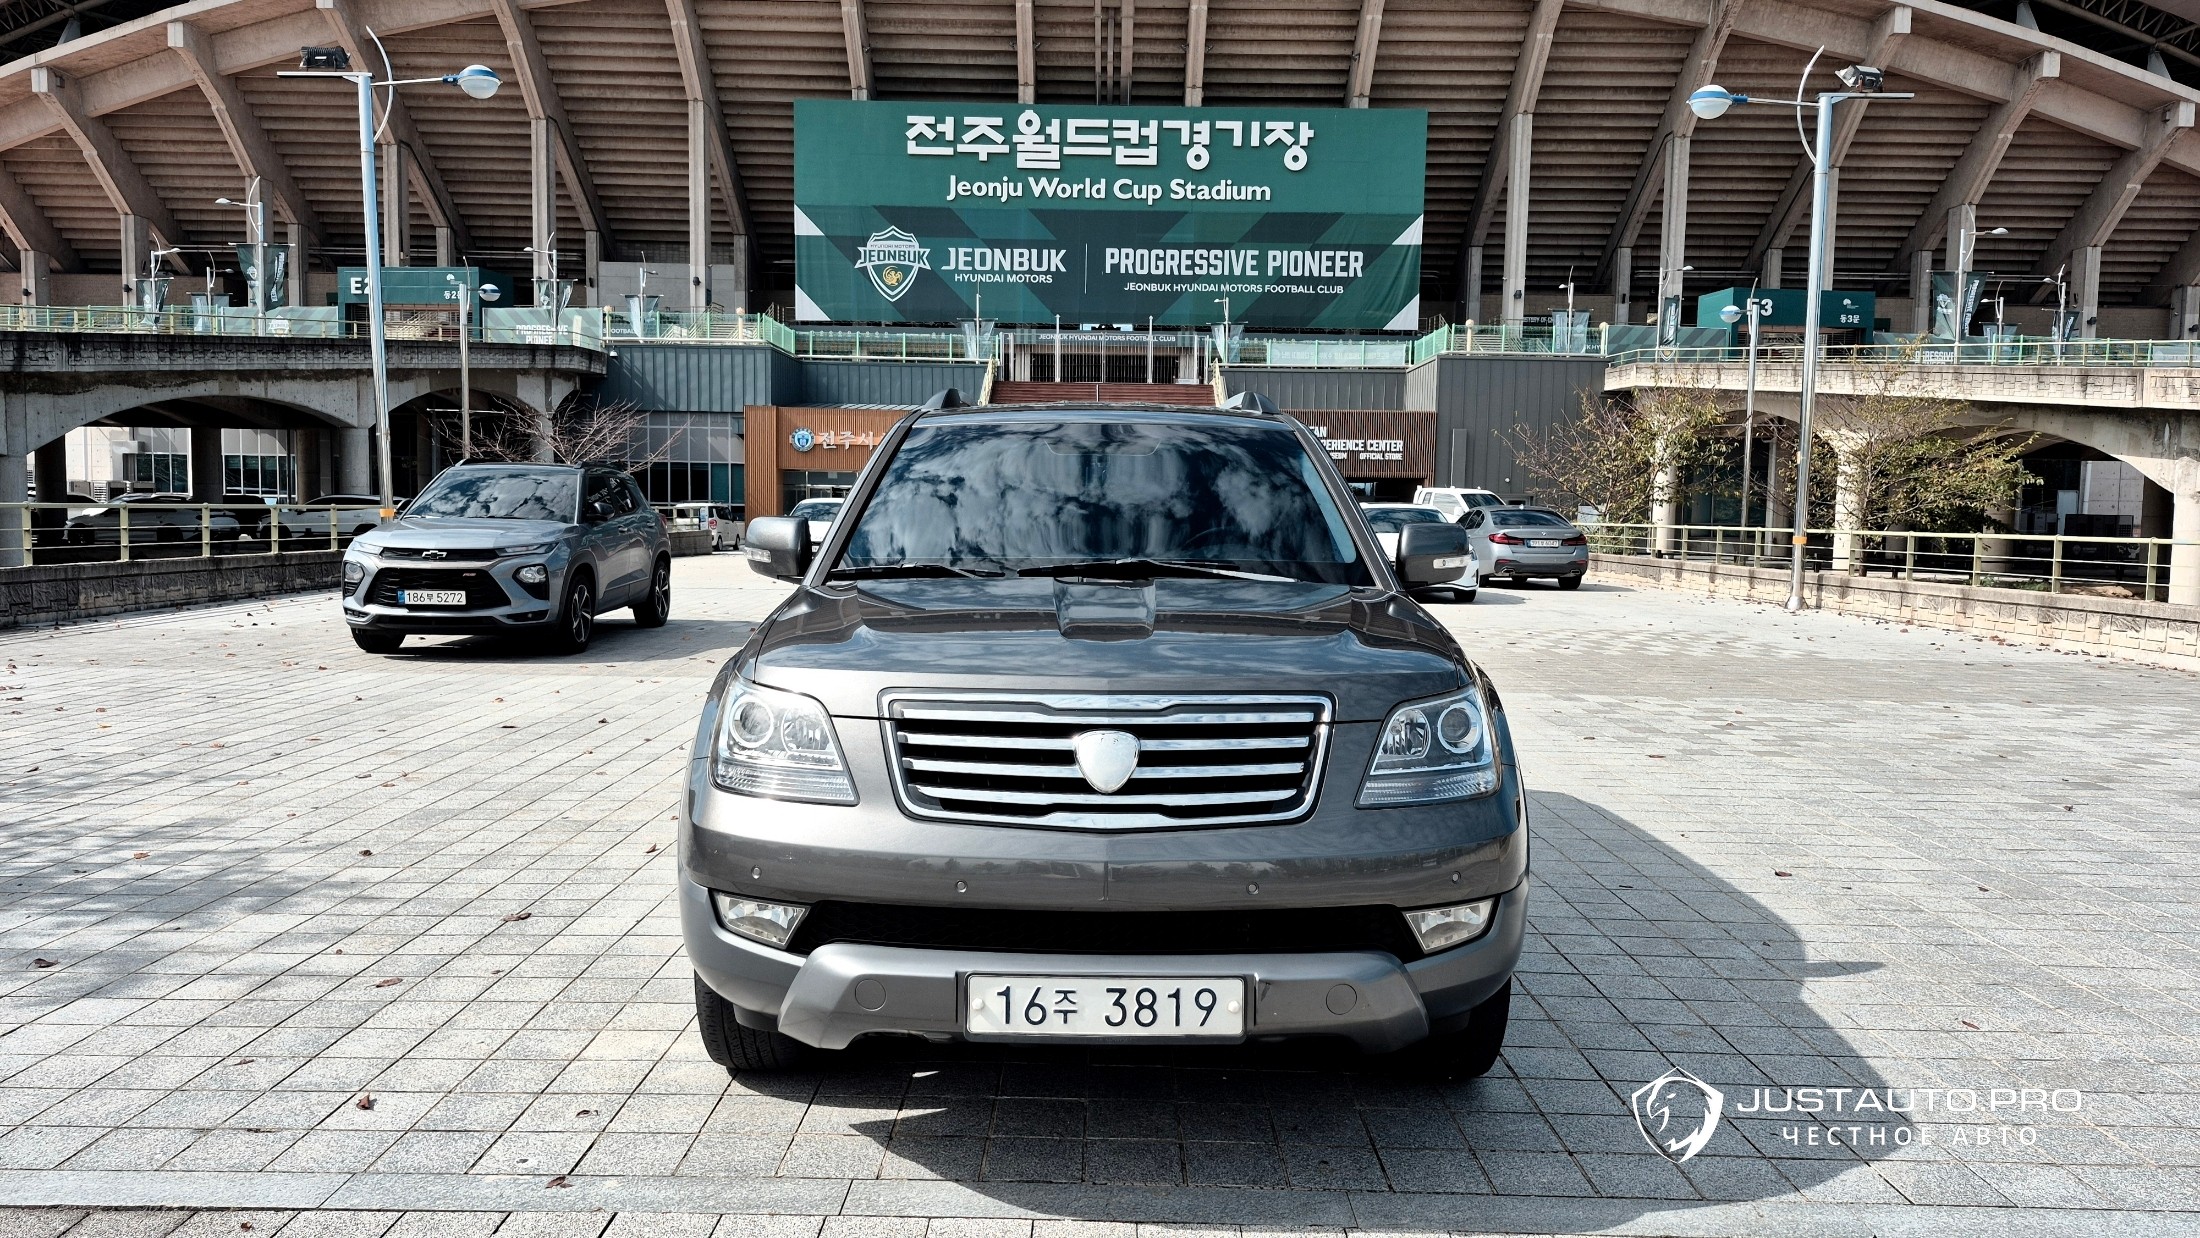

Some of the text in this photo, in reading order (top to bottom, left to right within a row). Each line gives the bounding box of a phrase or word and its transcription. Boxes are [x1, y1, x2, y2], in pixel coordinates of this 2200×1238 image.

[905, 110, 1314, 171] 전주월드컵경기장
[947, 175, 1271, 206] Jeonju World Cup Stadium
[860, 249, 926, 265] JEONBUK
[941, 247, 1067, 272] JEONBUK
[1105, 247, 1364, 277] PROGRESSIVE PIONEER
[954, 273, 1053, 284] HYUNDAI MOTORS
[1124, 282, 1344, 294] JEONBUK HYUNDAI MOTORS FOOTBALL CLUB
[1840, 314, 1860, 324] 동3문
[516, 324, 568, 335] PROGRESVE
[526, 336, 553, 345] PIONEE
[818, 430, 886, 451] 전주시
[1320, 440, 1404, 452] PERIENCE CENTER
[436, 592, 463, 603] 5272
[996, 985, 1218, 1028] 16주 3819
